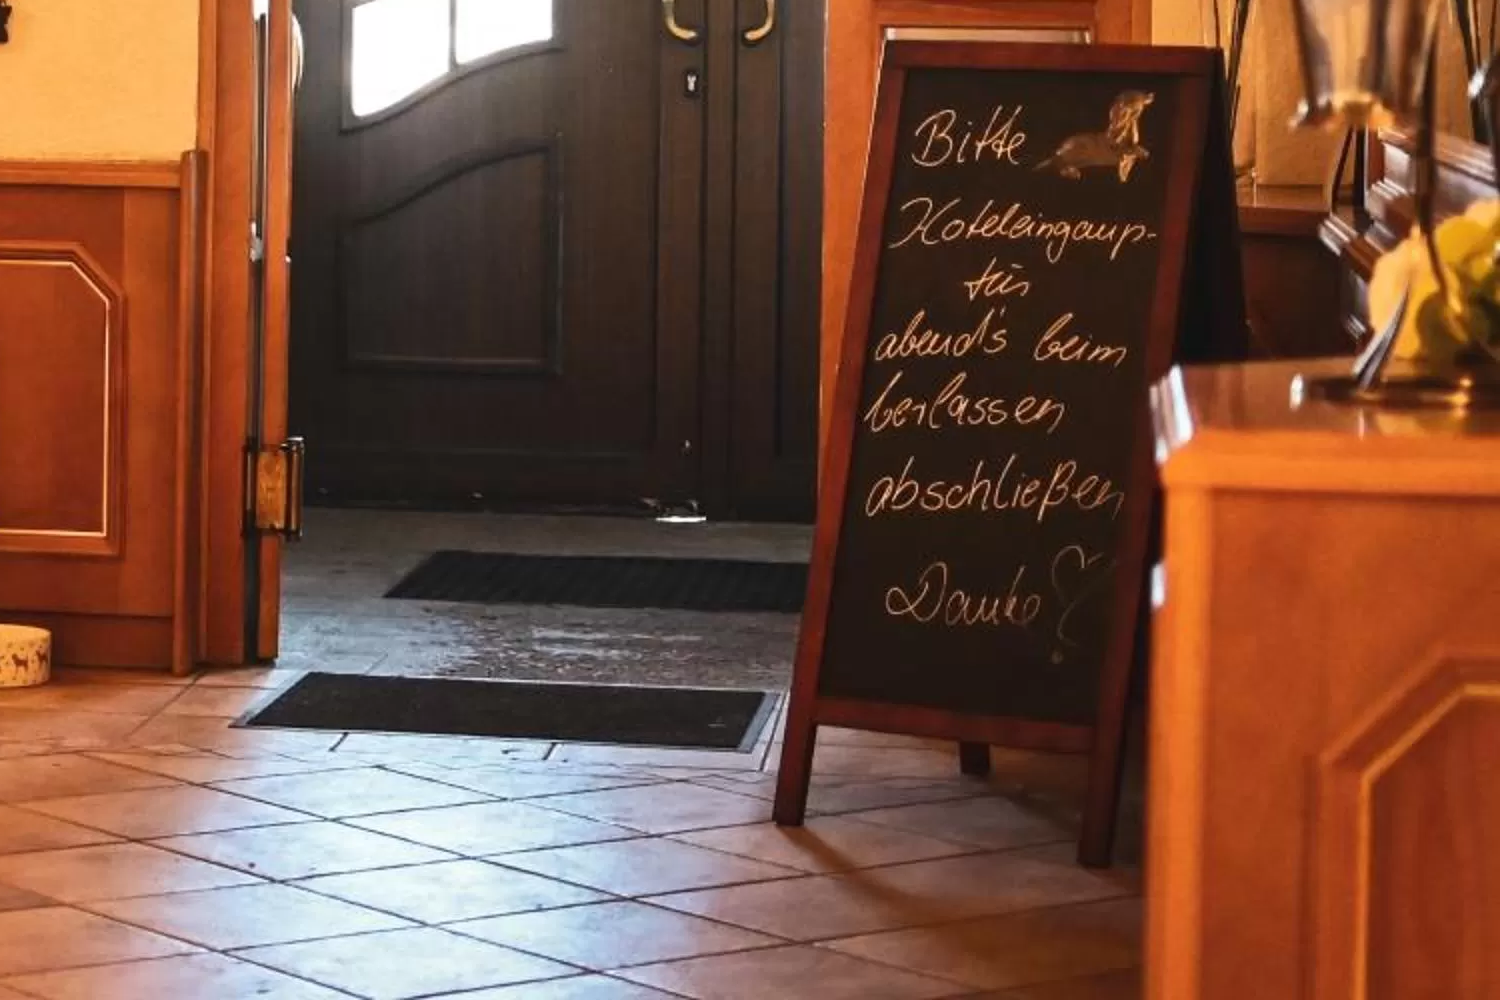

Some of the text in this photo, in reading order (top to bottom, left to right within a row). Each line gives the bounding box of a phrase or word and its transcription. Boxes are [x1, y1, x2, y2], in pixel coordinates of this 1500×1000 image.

[911, 104, 1025, 167] Bitte
[1033, 312, 1128, 368] beim
[885, 561, 1041, 625] Danke
